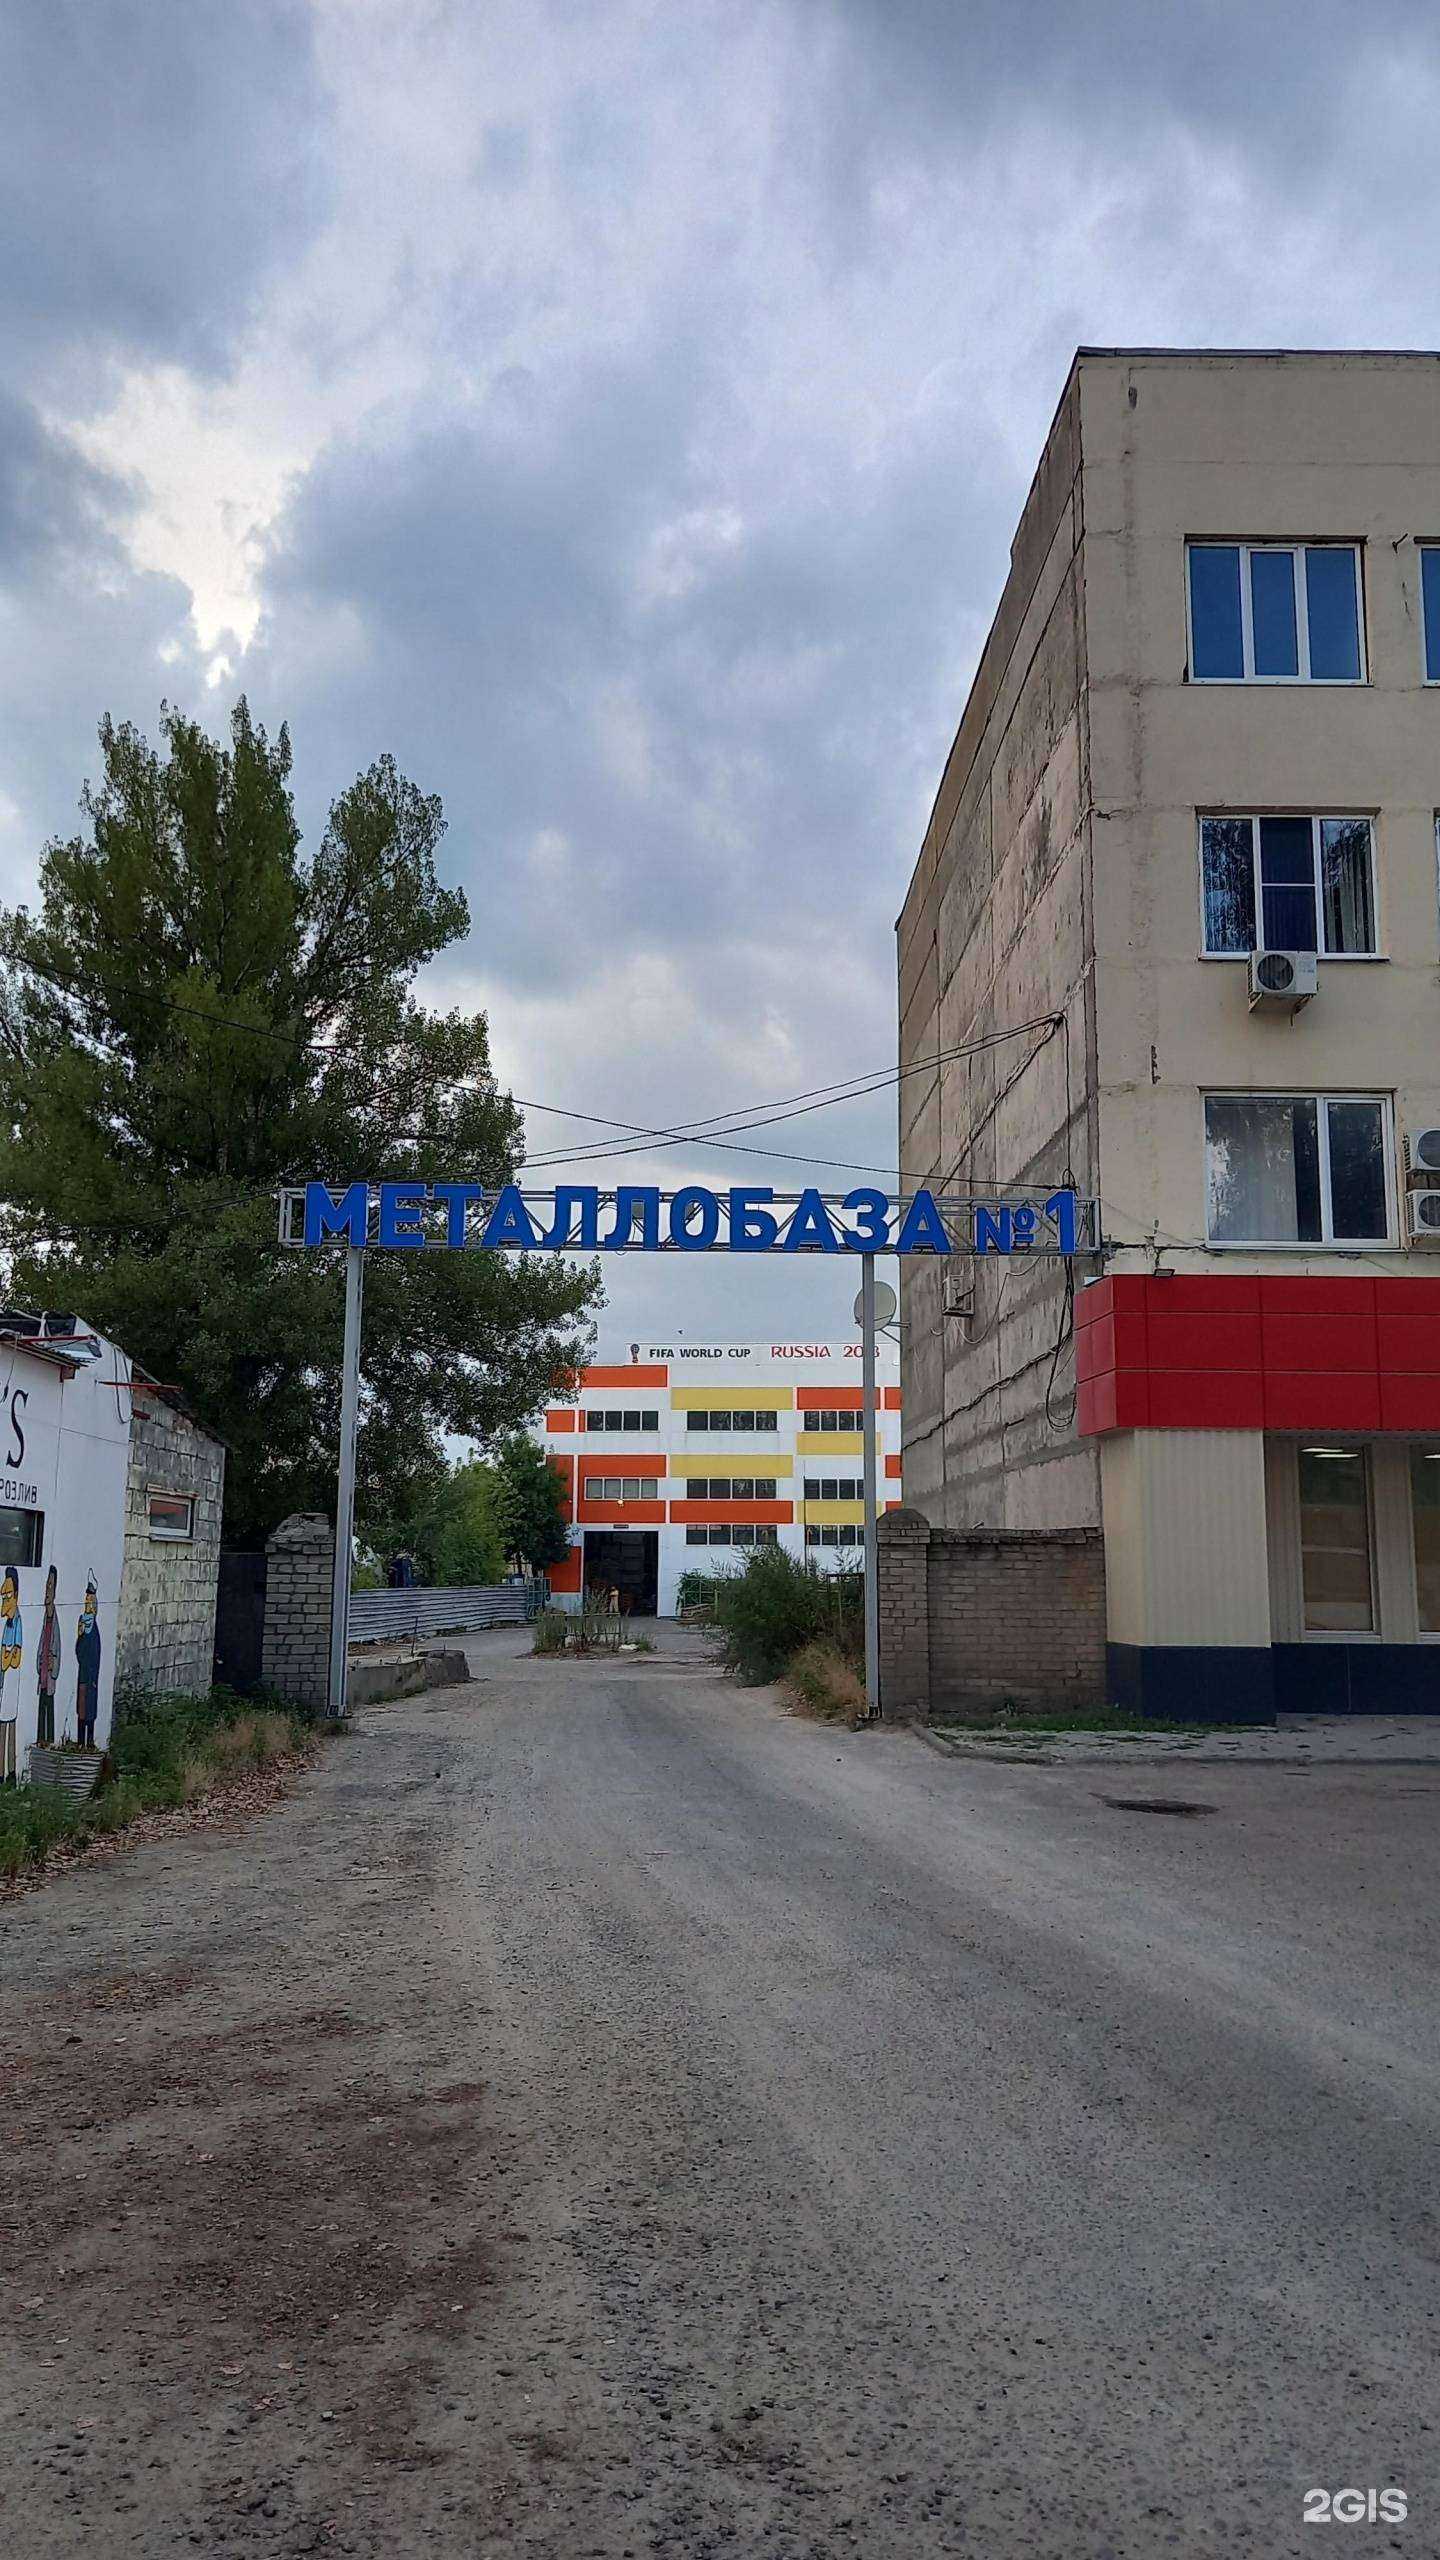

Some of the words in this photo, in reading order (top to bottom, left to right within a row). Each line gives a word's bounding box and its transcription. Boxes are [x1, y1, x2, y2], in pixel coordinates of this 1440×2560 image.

[304, 1183, 953, 1253] МЕТАЛЛОБАЗА
[975, 1207, 1035, 1254] №
[1045, 1191, 1075, 1254] 1
[649, 1348, 674, 1358] FIFA
[680, 1348, 723, 1358] WORLD
[728, 1348, 751, 1358] CUP
[771, 1345, 831, 1358] RUSSIA
[843, 1345, 880, 1358] 208
